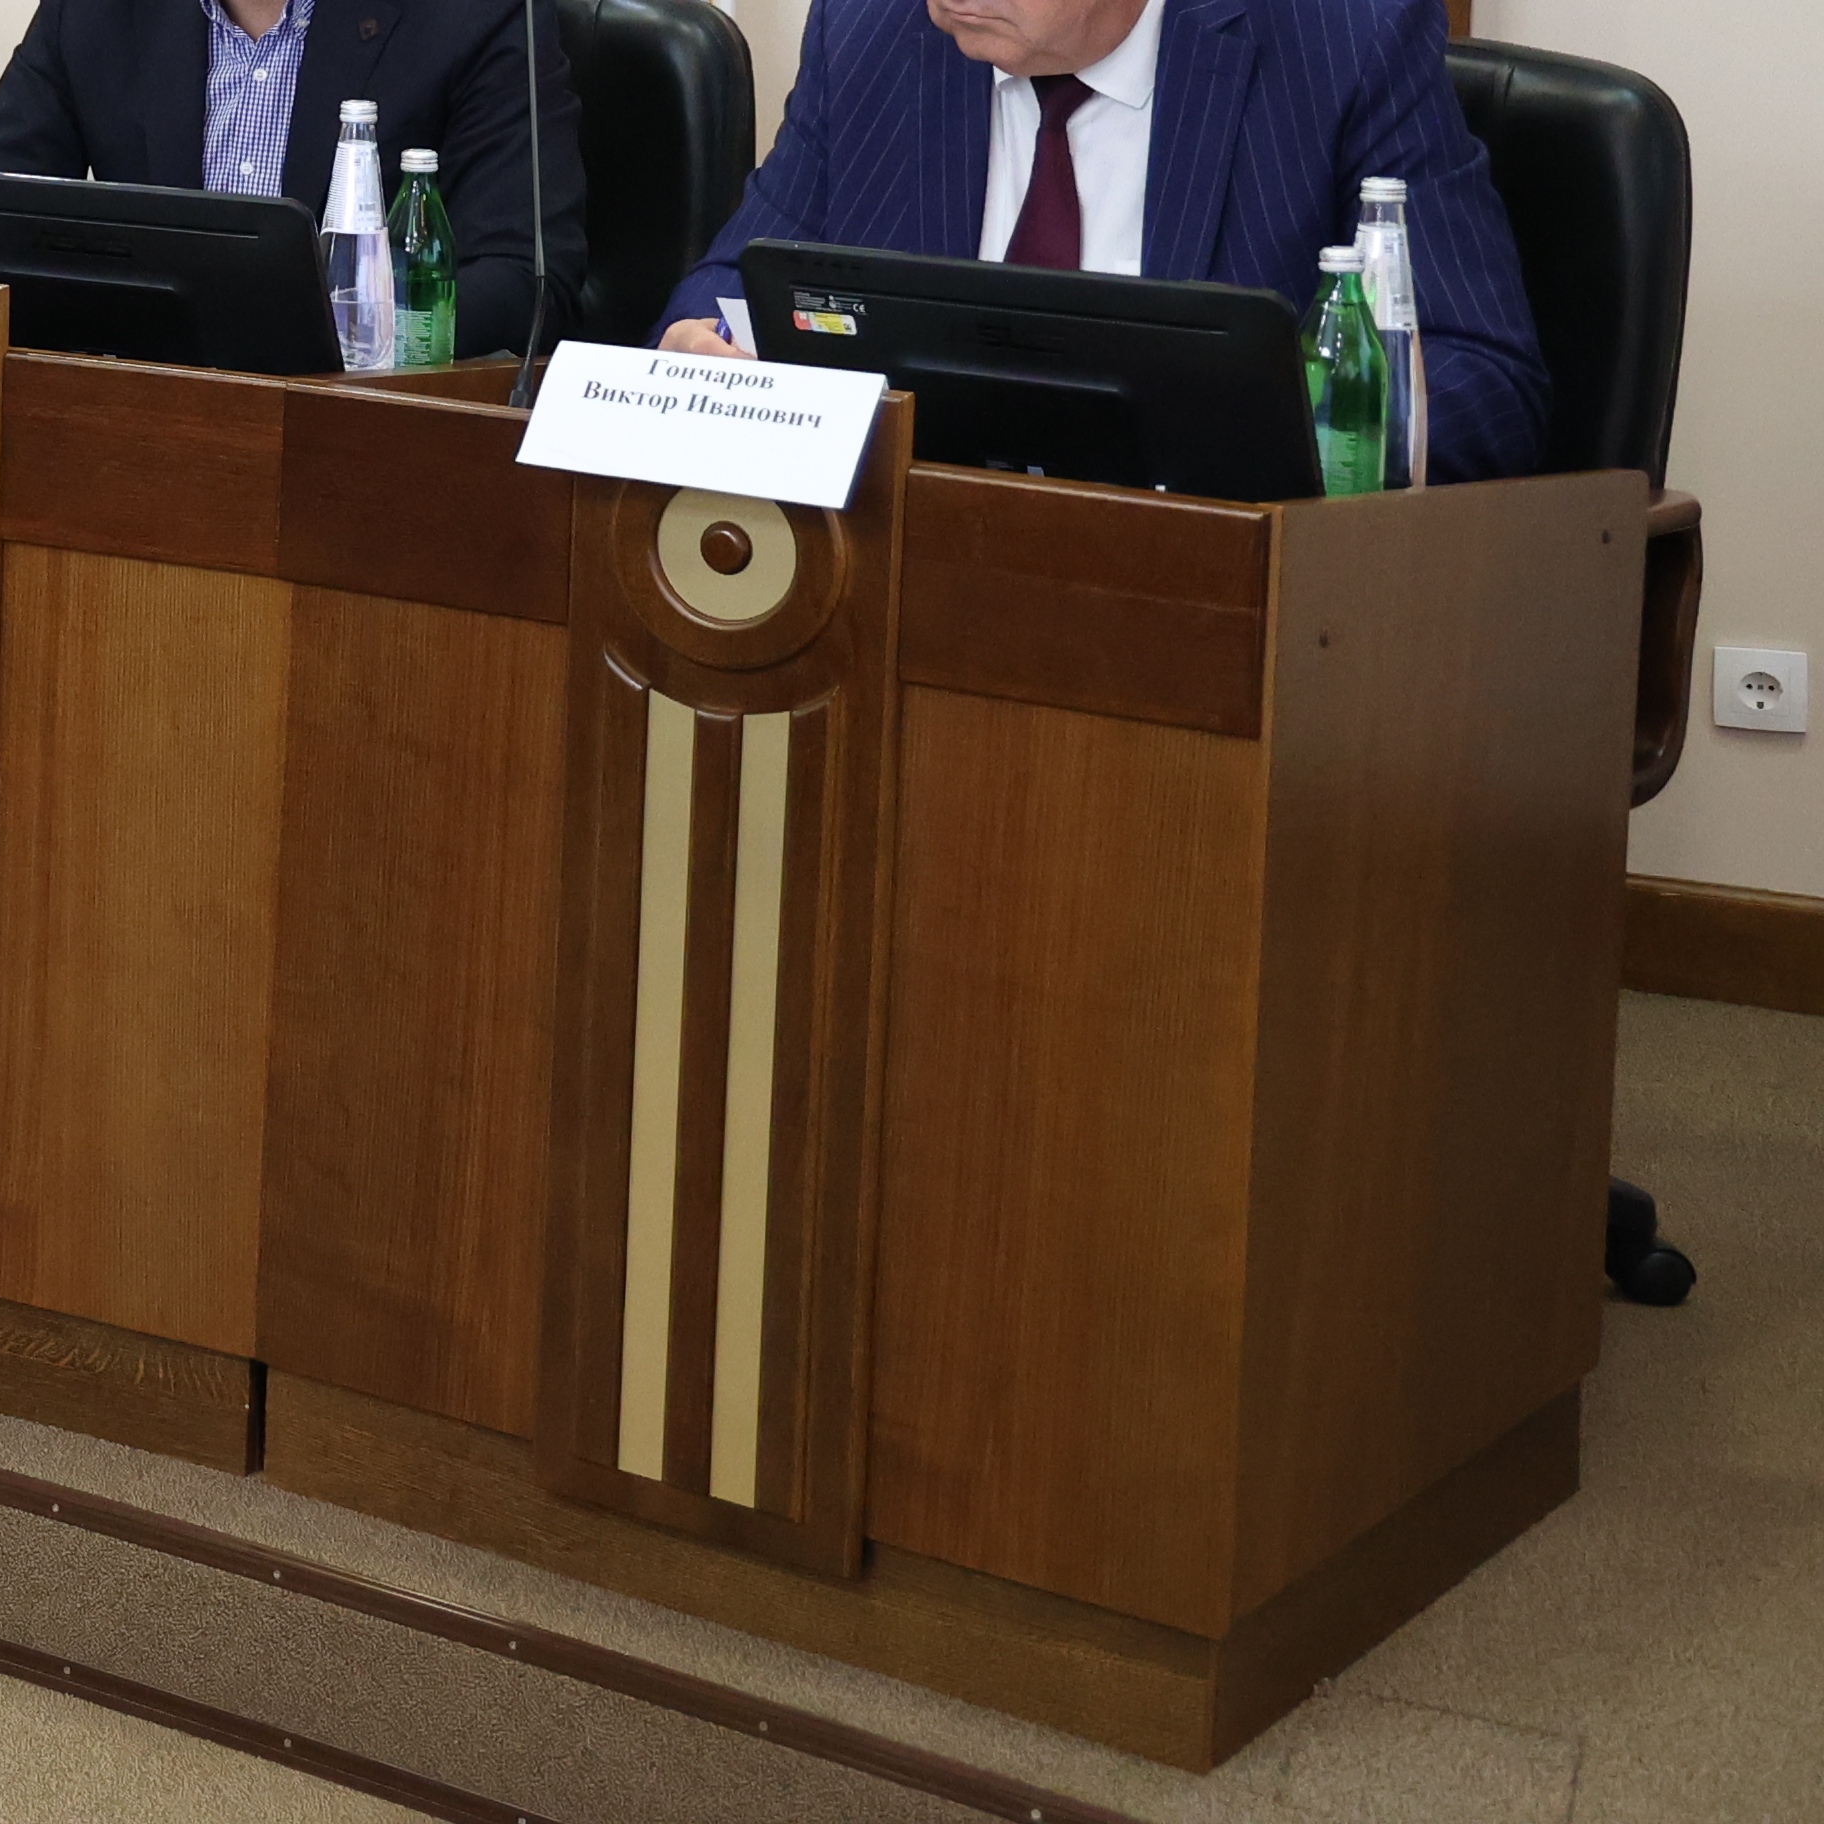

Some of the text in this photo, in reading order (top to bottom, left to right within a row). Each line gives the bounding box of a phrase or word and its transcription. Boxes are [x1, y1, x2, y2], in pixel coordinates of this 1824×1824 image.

[647, 358, 775, 391] Гончаров
[581, 379, 823, 430] Виктор Иванович
